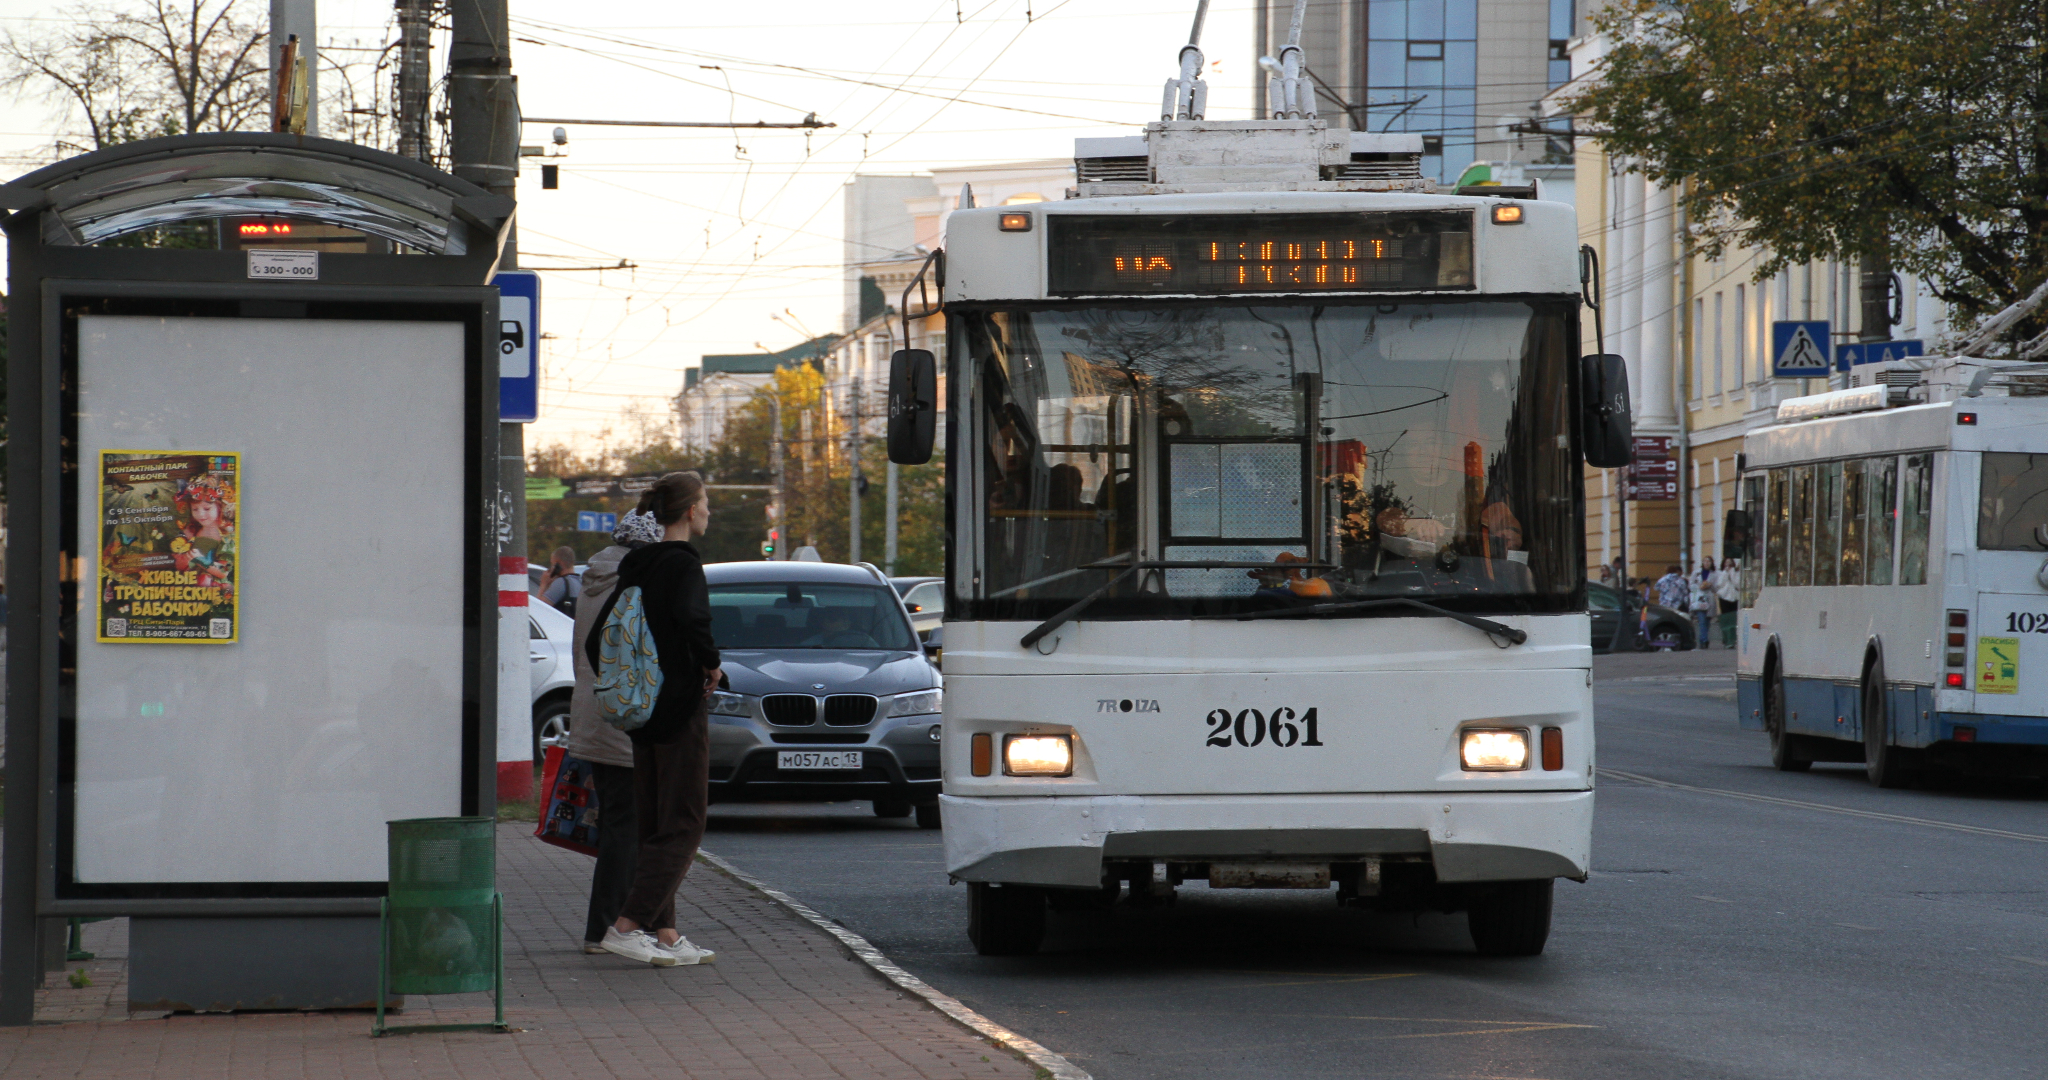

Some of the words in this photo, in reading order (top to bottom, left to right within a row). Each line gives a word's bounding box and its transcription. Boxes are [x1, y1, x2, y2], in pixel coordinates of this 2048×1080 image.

[263, 266, 284, 274] 300
[292, 266, 313, 275] 000
[107, 463, 164, 474] КОНТАКТНЫЙ
[165, 462, 189, 471] ПАРК
[129, 473, 169, 481] БАБОЧЕК
[125, 506, 169, 515] Сентября
[133, 515, 173, 524] Октября
[139, 569, 198, 585] ЖИВЫЕ
[113, 585, 222, 600] ТРОПИЧЕСКИЕ
[131, 601, 211, 616] БАБОЧКИ
[1206, 707, 1323, 748] 2061
[844, 753, 858, 763] 13
